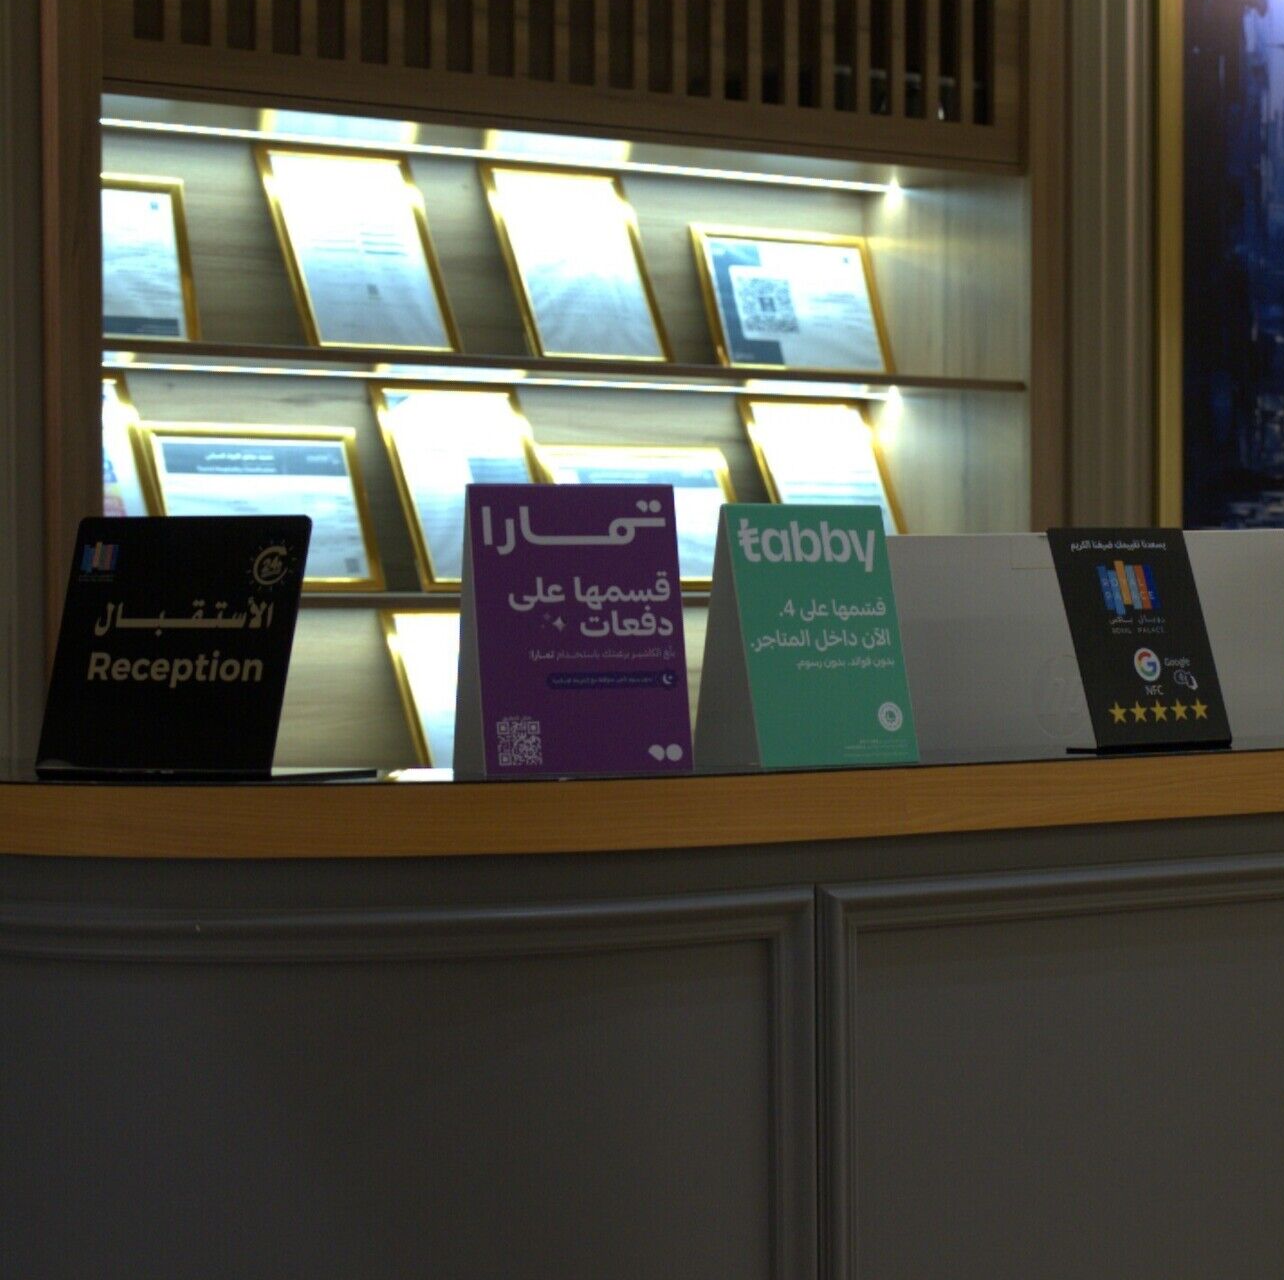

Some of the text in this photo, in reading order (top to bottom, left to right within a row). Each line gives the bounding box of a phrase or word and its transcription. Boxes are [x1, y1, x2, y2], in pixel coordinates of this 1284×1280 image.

[481, 499, 667, 556] تمارا
[738, 518, 875, 573] tabby
[508, 570, 671, 612] قسمها على
[580, 605, 674, 637] دفعات
[800, 599, 830, 622] على
[815, 628, 858, 652] داخل
[87, 650, 265, 689] Reception
[1144, 684, 1164, 696] NFC
